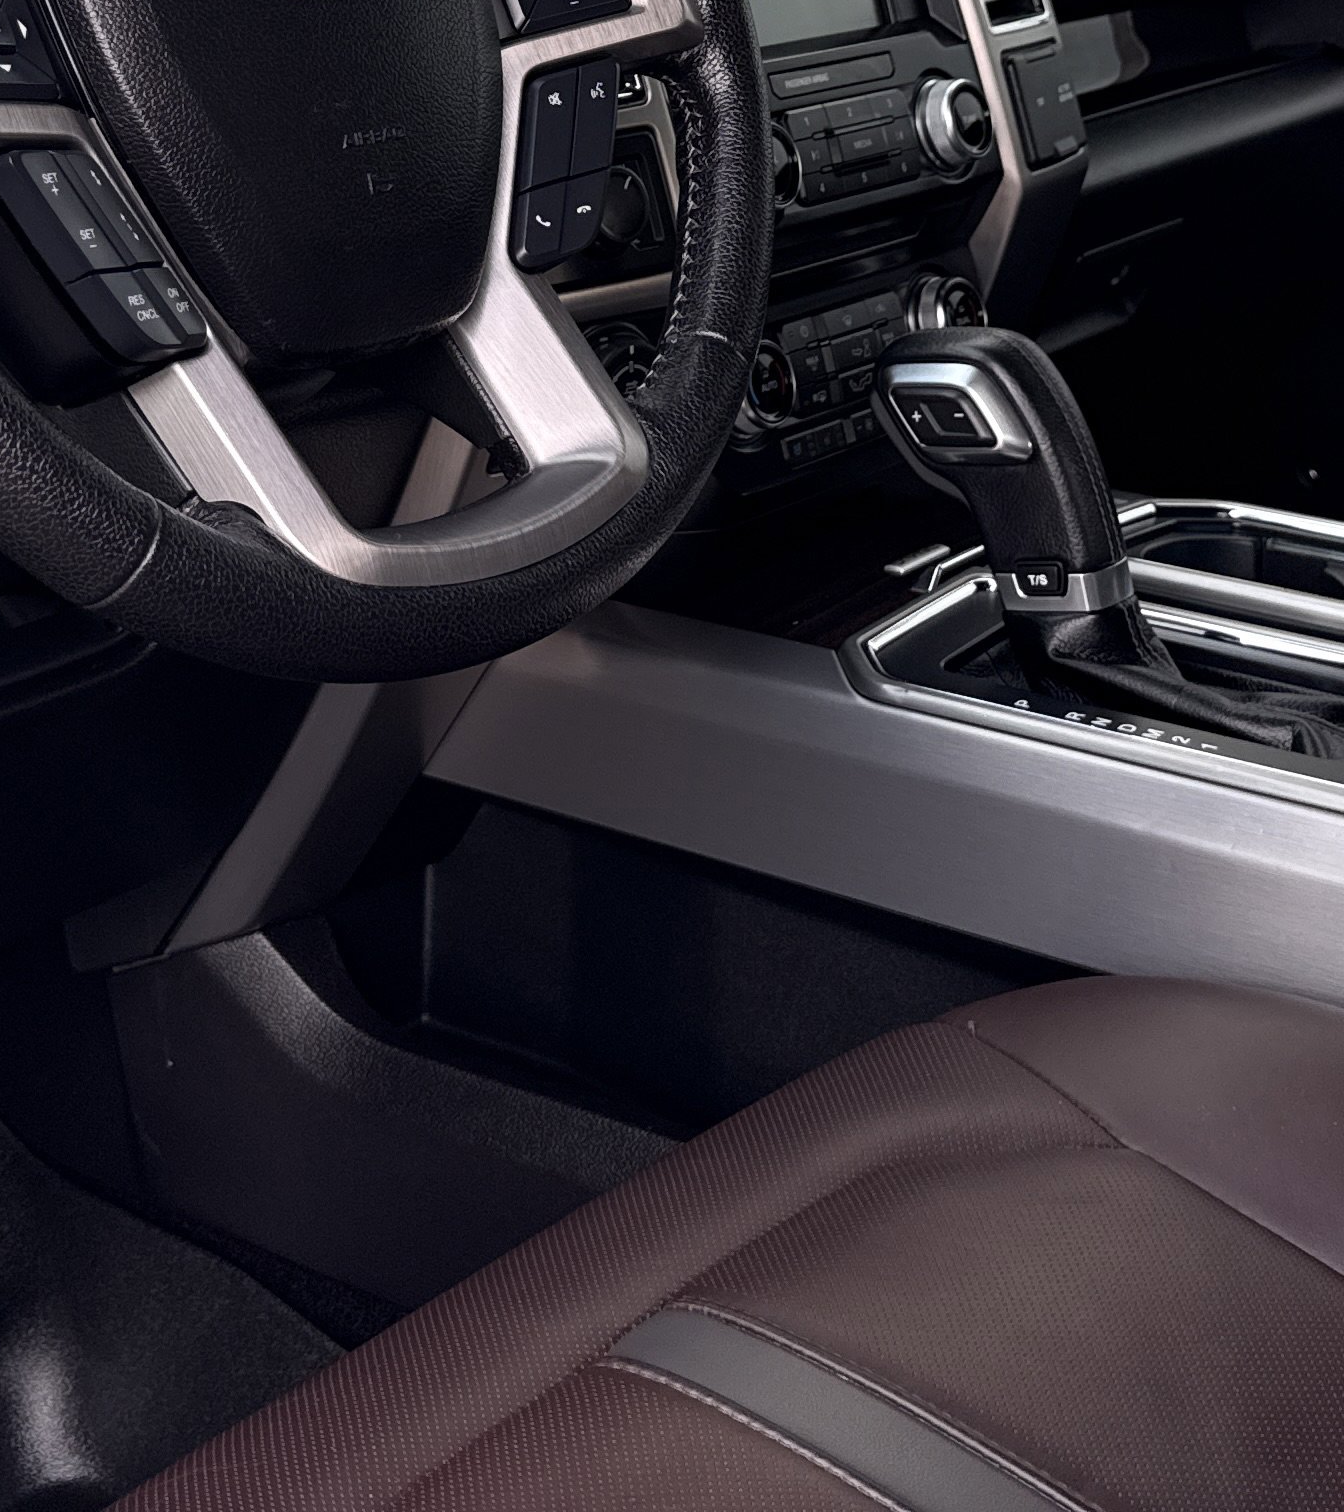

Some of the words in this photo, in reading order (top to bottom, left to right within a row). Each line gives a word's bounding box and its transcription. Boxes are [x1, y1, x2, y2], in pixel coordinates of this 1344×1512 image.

[41, 172, 58, 184] SET
[79, 228, 96, 240] SET
[167, 287, 180, 298] ON
[127, 293, 146, 307] RES
[175, 301, 190, 313] OFF
[136, 308, 160, 322] CNCL
[1027, 573, 1048, 587] T/S
[1013, 699, 1031, 709] P
[1064, 711, 1087, 722] R
[1090, 716, 1113, 727] N
[1116, 723, 1137, 733] D
[1141, 728, 1165, 740] M
[1171, 734, 1192, 744] 2
[1201, 742, 1219, 751] 1
